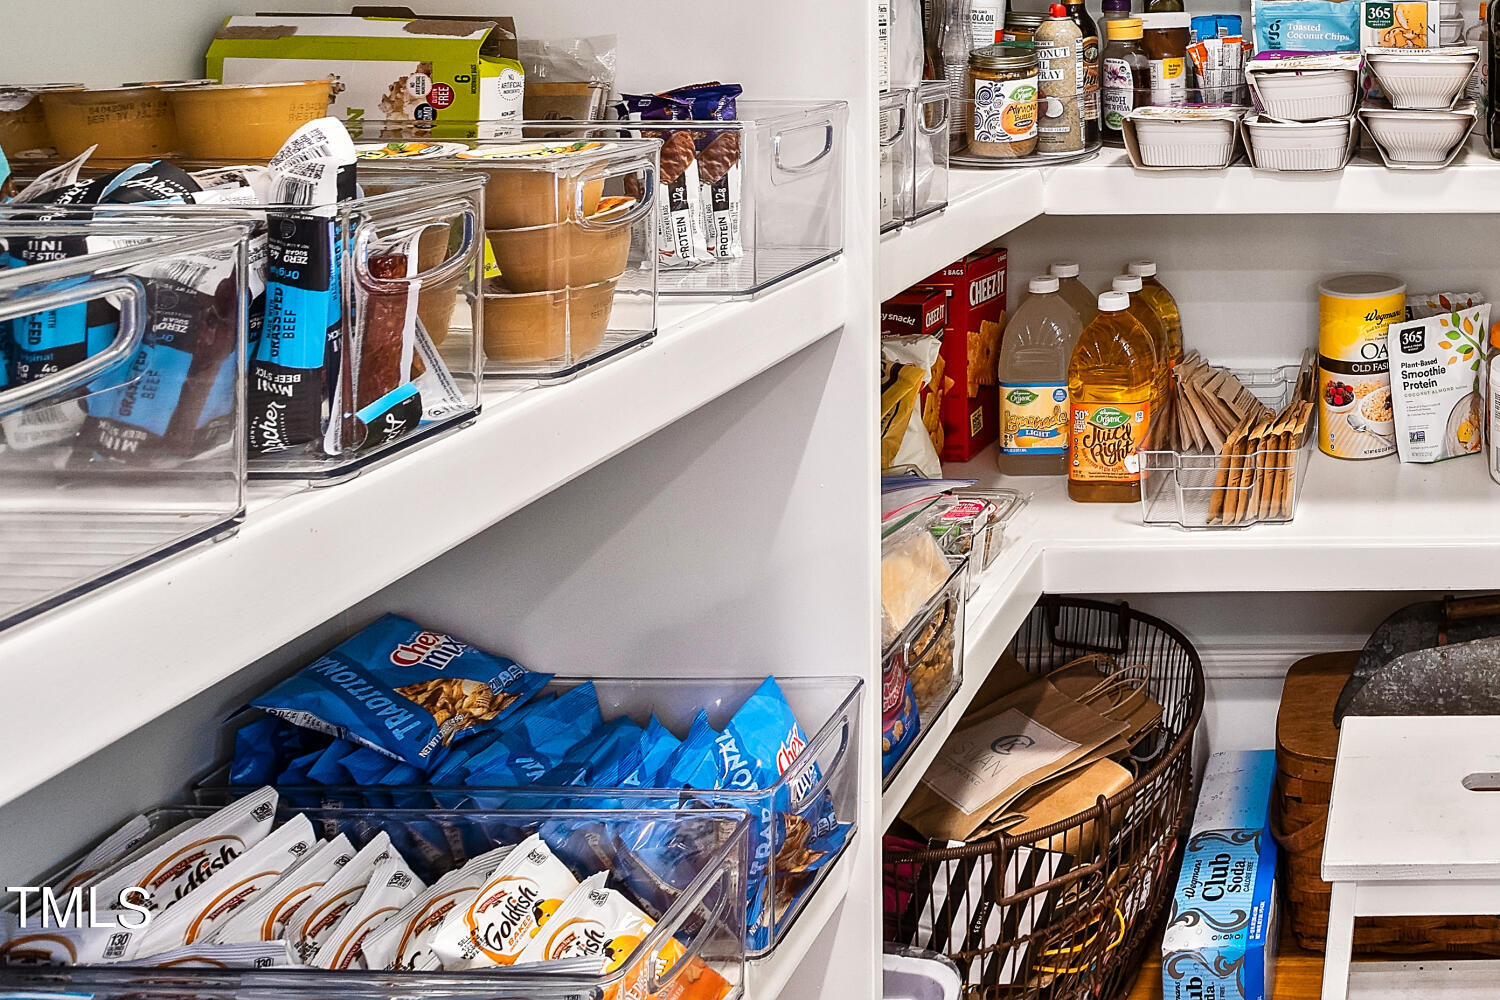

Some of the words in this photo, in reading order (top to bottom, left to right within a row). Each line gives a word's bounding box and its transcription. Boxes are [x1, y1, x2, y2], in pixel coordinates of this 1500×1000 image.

[985, 14, 995, 22] OIL
[1368, 7, 1391, 19] 365
[1287, 23, 1321, 32] Toasted
[1287, 32, 1323, 40] Coconut
[1325, 32, 1350, 41] Chips
[455, 74, 471, 83] 6
[438, 86, 449, 106] FREE
[672, 187, 685, 204] 12g
[715, 187, 727, 204] 12g
[718, 216, 729, 257] PROTEIN
[284, 255, 308, 264] ZERO
[283, 309, 297, 339] BEEF
[889, 312, 916, 326] snack!
[1402, 330, 1423, 345] 365
[1352, 363, 1370, 373] OLD
[1400, 358, 1438, 369] Plant-Based
[274, 374, 301, 383] BEEF
[1402, 366, 1446, 380] Smoothie
[1403, 379, 1438, 391] Protein
[1010, 395, 1032, 404] Organic
[1096, 414, 1123, 426] Organic
[1025, 429, 1051, 438] LIGHT
[1091, 436, 1135, 467] Right
[391, 631, 443, 667] Chex
[253, 801, 270, 816] 130
[290, 842, 307, 856] 130
[1182, 860, 1203, 899] Wegmans
[1202, 853, 1231, 902] Club
[1227, 857, 1246, 893] Soda
[484, 884, 539, 952] Goldfish
[508, 914, 533, 947] BAKED
[109, 934, 129, 948] 130
